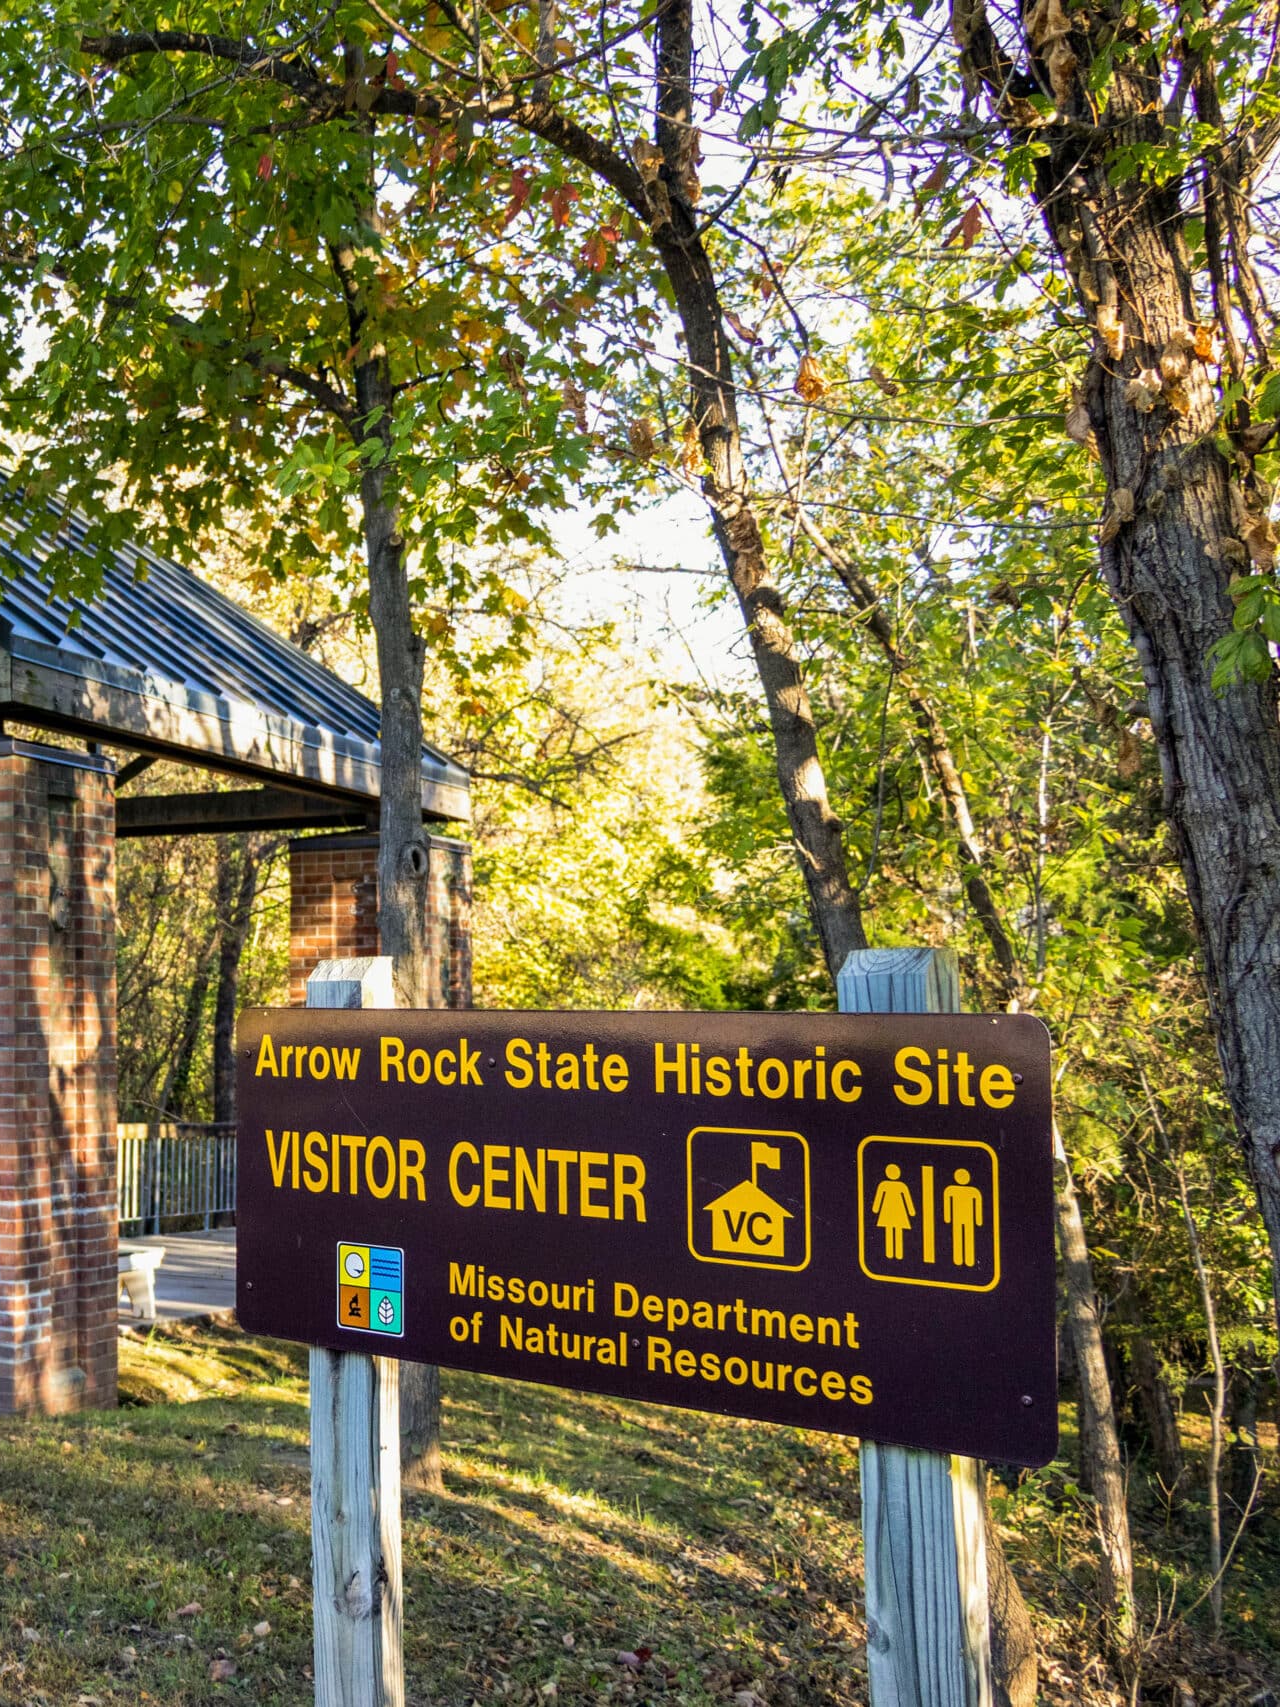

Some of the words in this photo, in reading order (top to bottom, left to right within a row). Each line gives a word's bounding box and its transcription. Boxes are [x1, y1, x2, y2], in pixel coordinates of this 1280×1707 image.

[254, 1033, 361, 1081] Arrow
[379, 1037, 484, 1086] Rock
[505, 1038, 629, 1093] State
[655, 1042, 863, 1103] Historic
[894, 1046, 1016, 1109] Site
[265, 1130, 427, 1202] VISITOR
[449, 1141, 647, 1223] CENTER
[722, 1209, 773, 1246] VC
[450, 1262, 595, 1313] Missouri
[615, 1282, 860, 1350] Department
[450, 1312, 483, 1344] of
[501, 1315, 628, 1367] Natural
[648, 1336, 874, 1405] Resources
